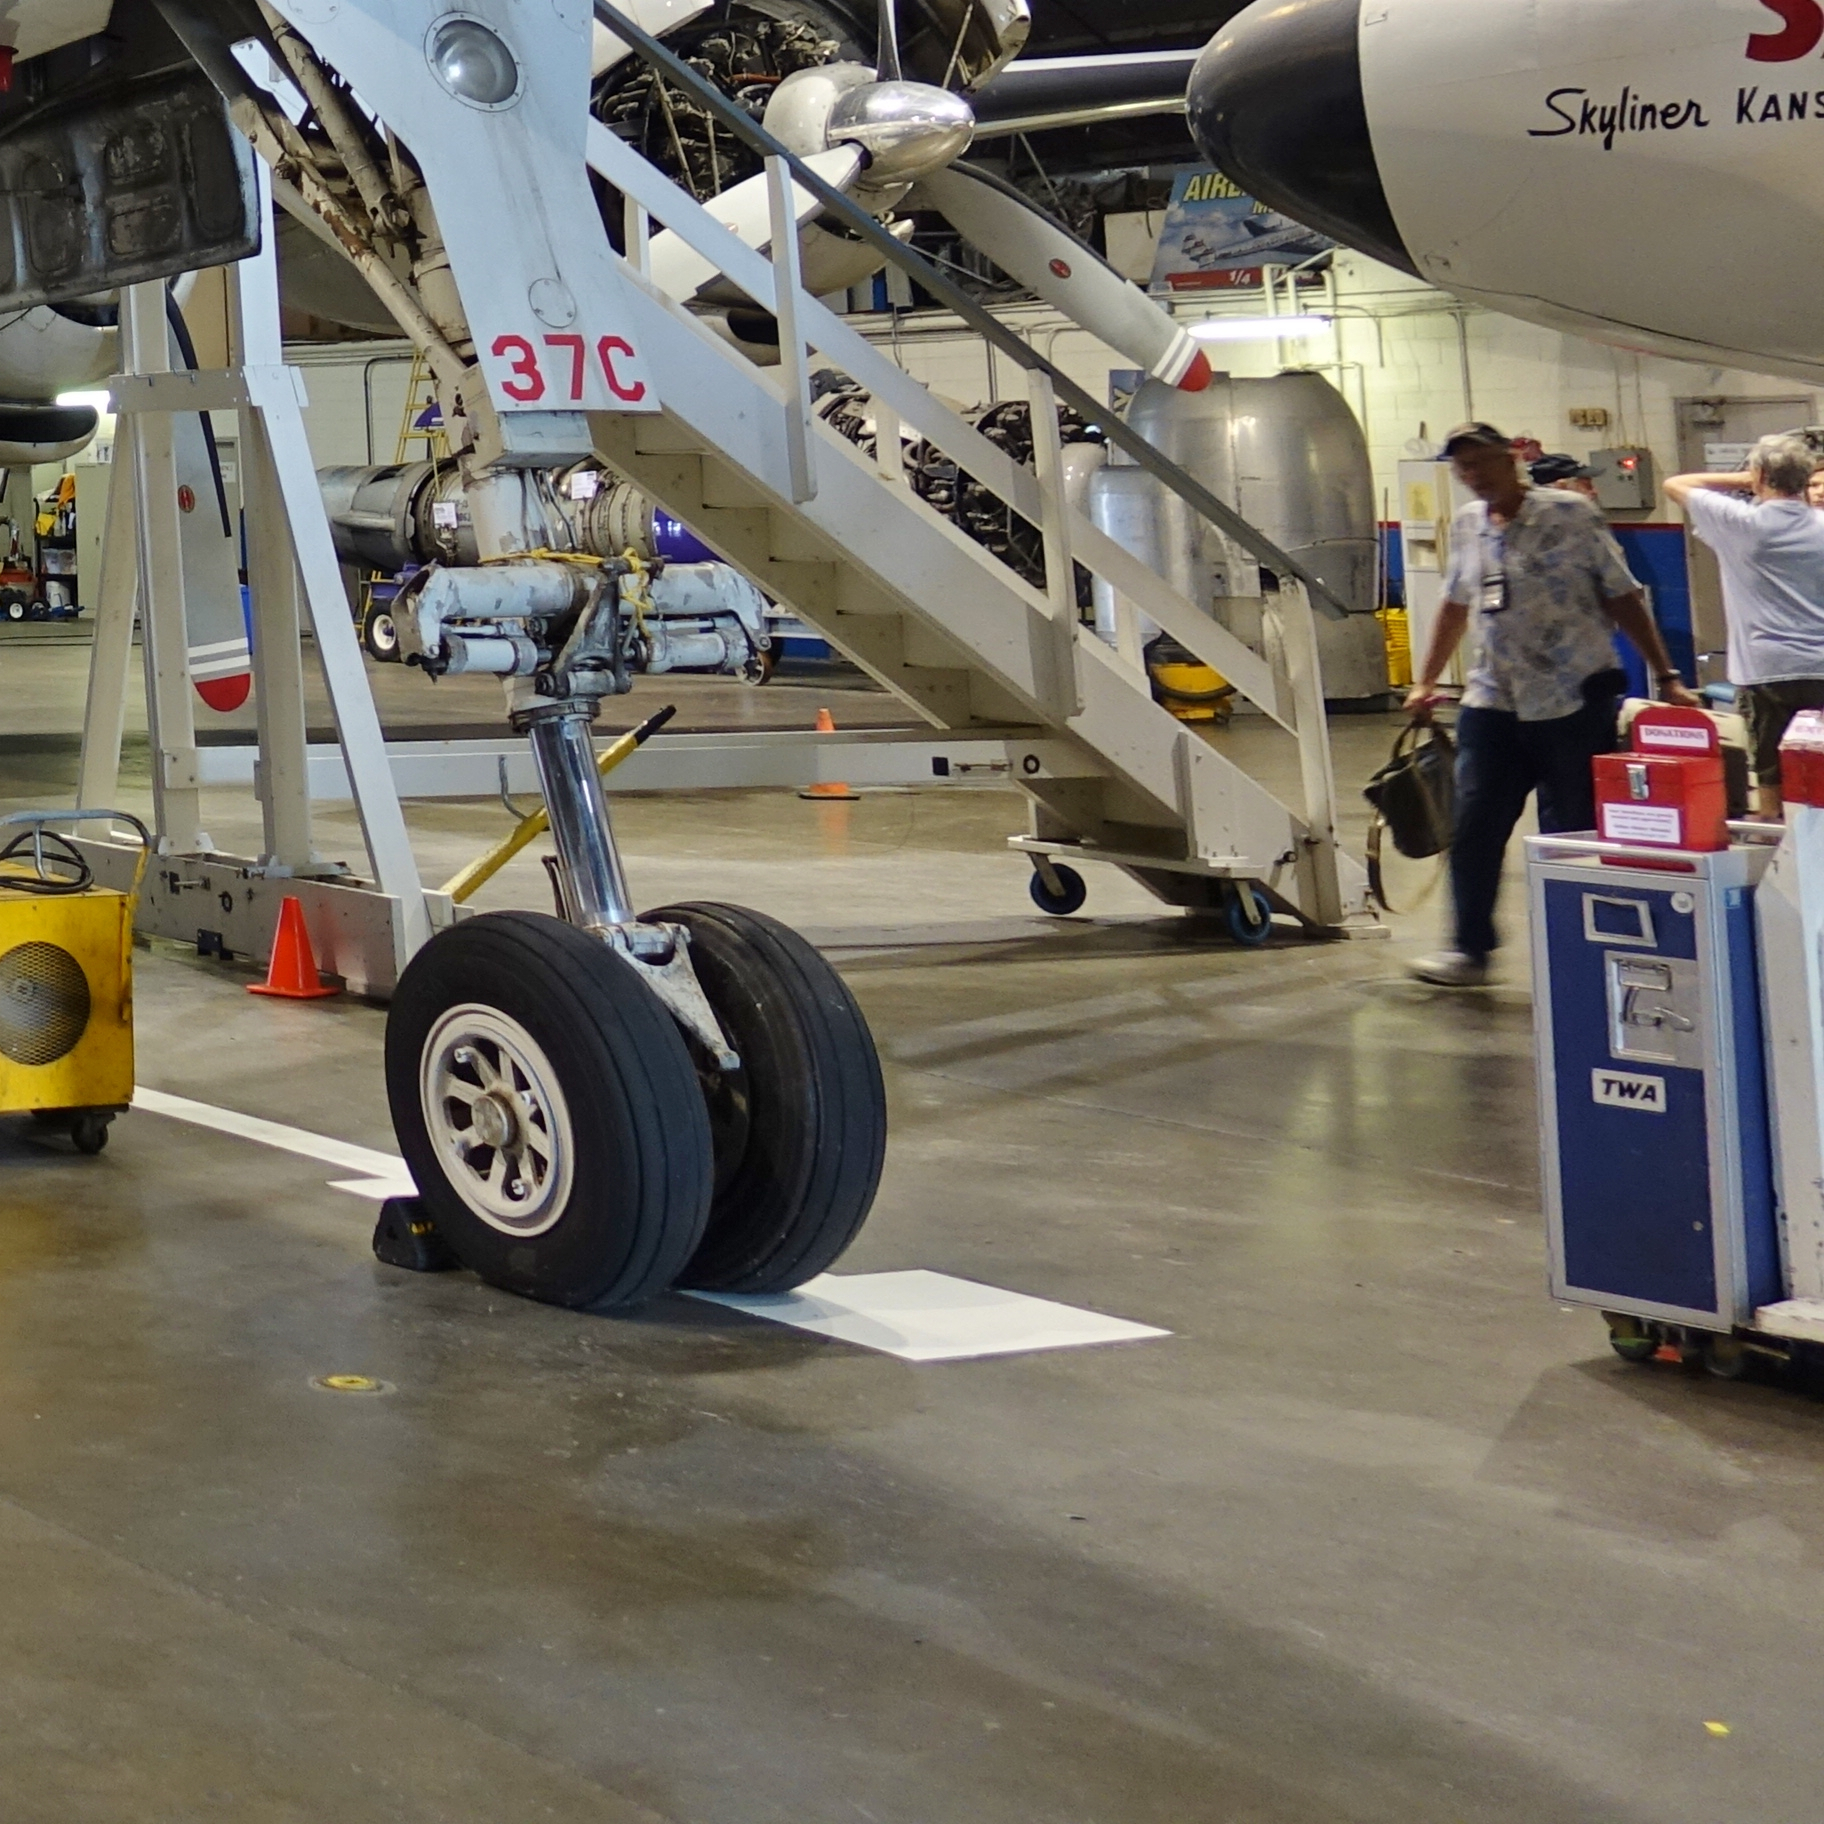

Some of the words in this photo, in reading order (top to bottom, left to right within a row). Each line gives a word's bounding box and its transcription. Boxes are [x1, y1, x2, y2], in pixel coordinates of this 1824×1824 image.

[1527, 85, 1711, 151] Skyliner
[1182, 172, 1247, 203] AIRL
[490, 334, 646, 402] 37C
[1601, 1078, 1657, 1103] TWA
